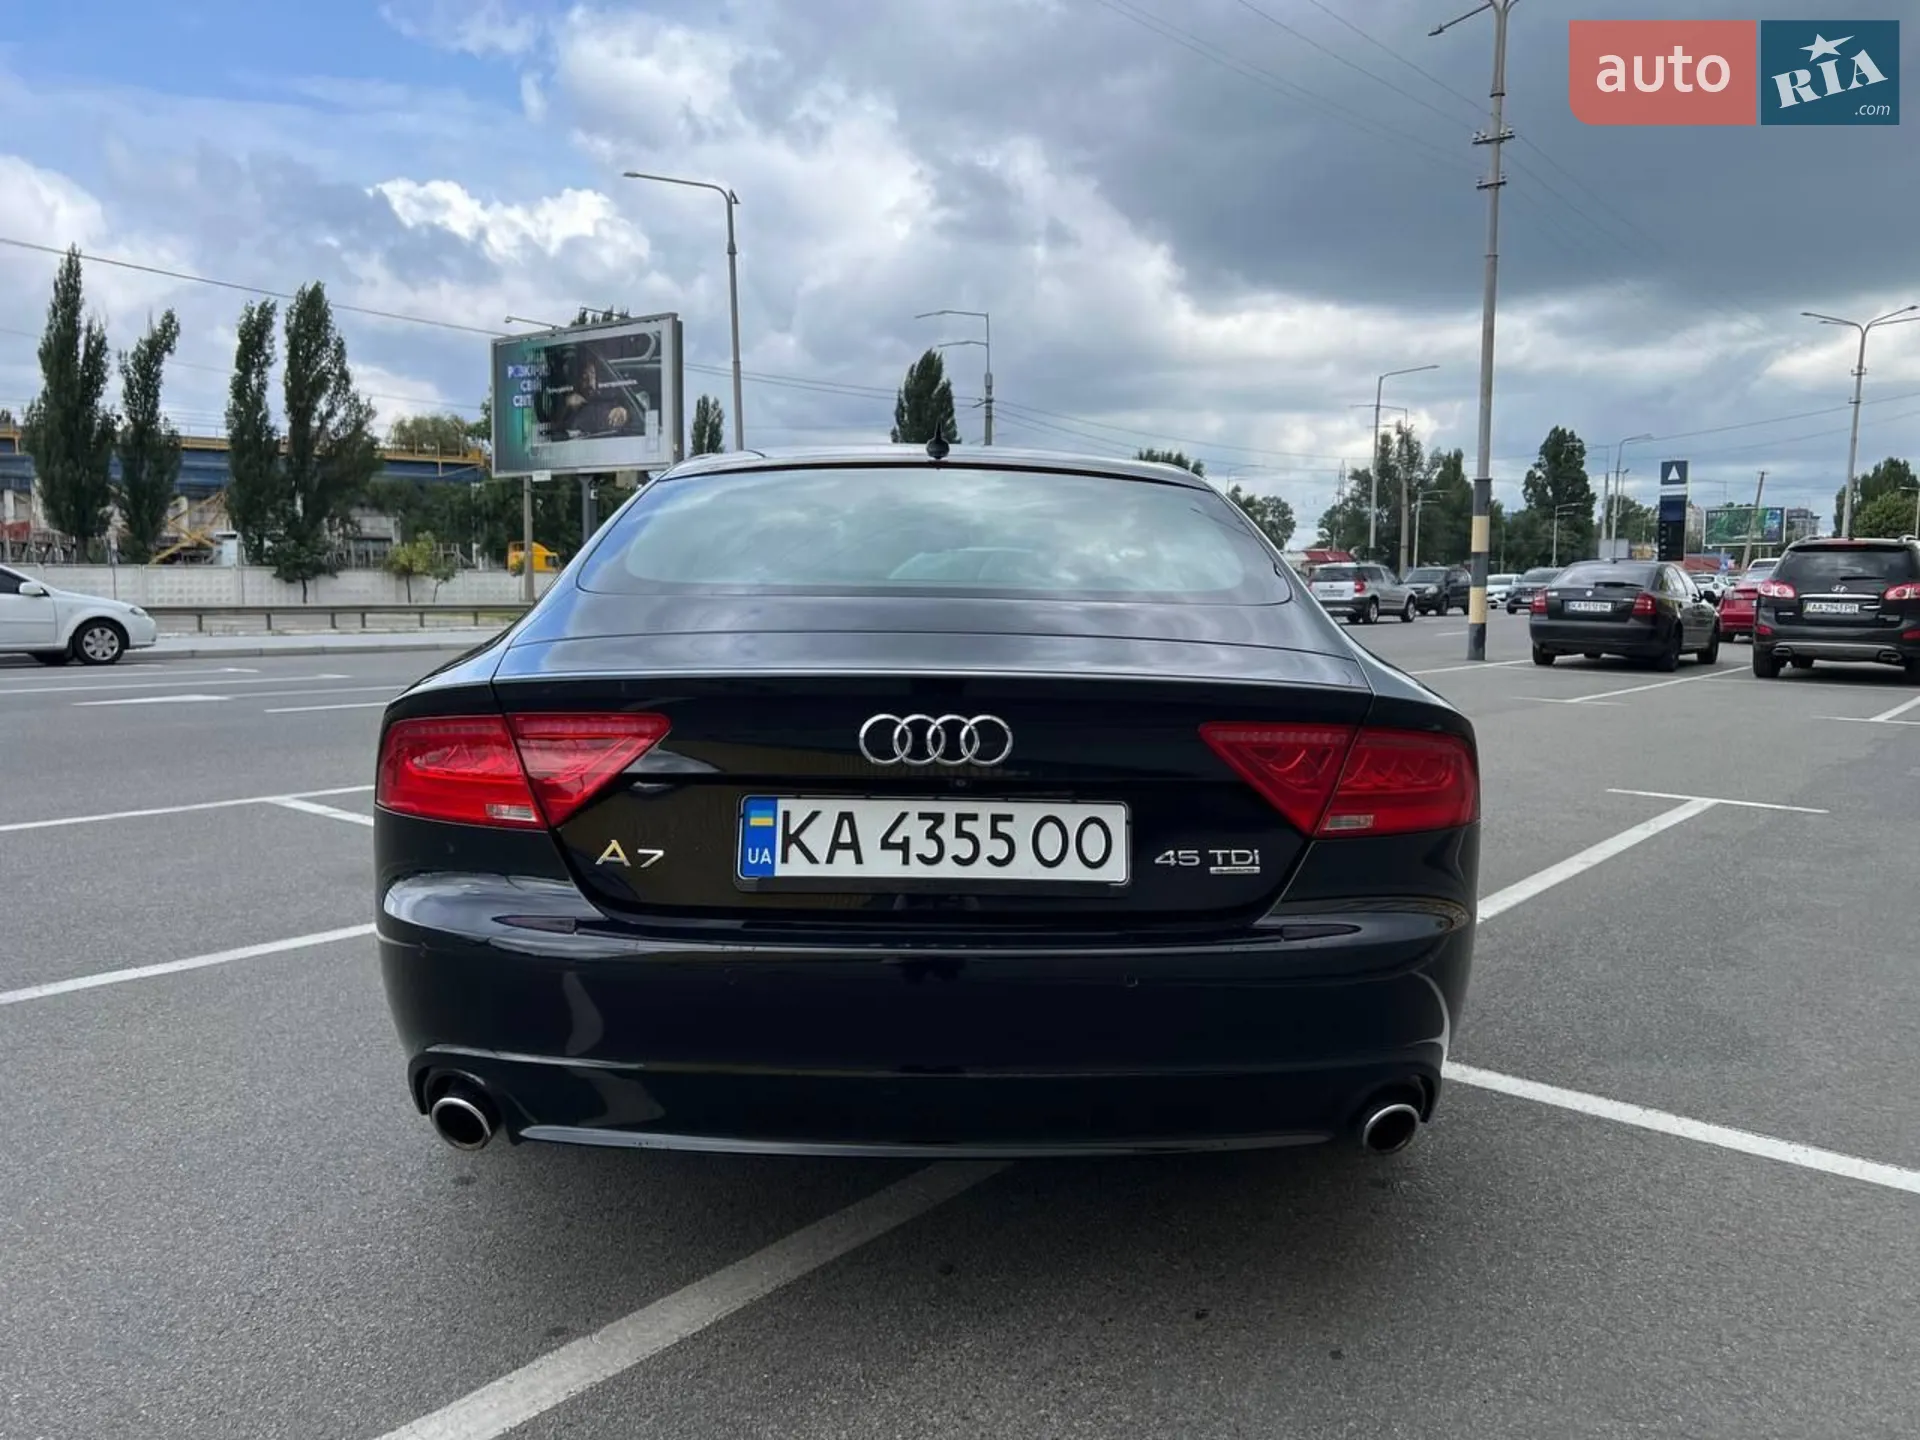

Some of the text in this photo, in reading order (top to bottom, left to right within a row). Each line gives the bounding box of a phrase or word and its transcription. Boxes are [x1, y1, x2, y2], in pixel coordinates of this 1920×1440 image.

[780, 810, 1113, 869] KA 4355 OO
[747, 848, 772, 865] UA
[1154, 850, 1201, 866] 45
